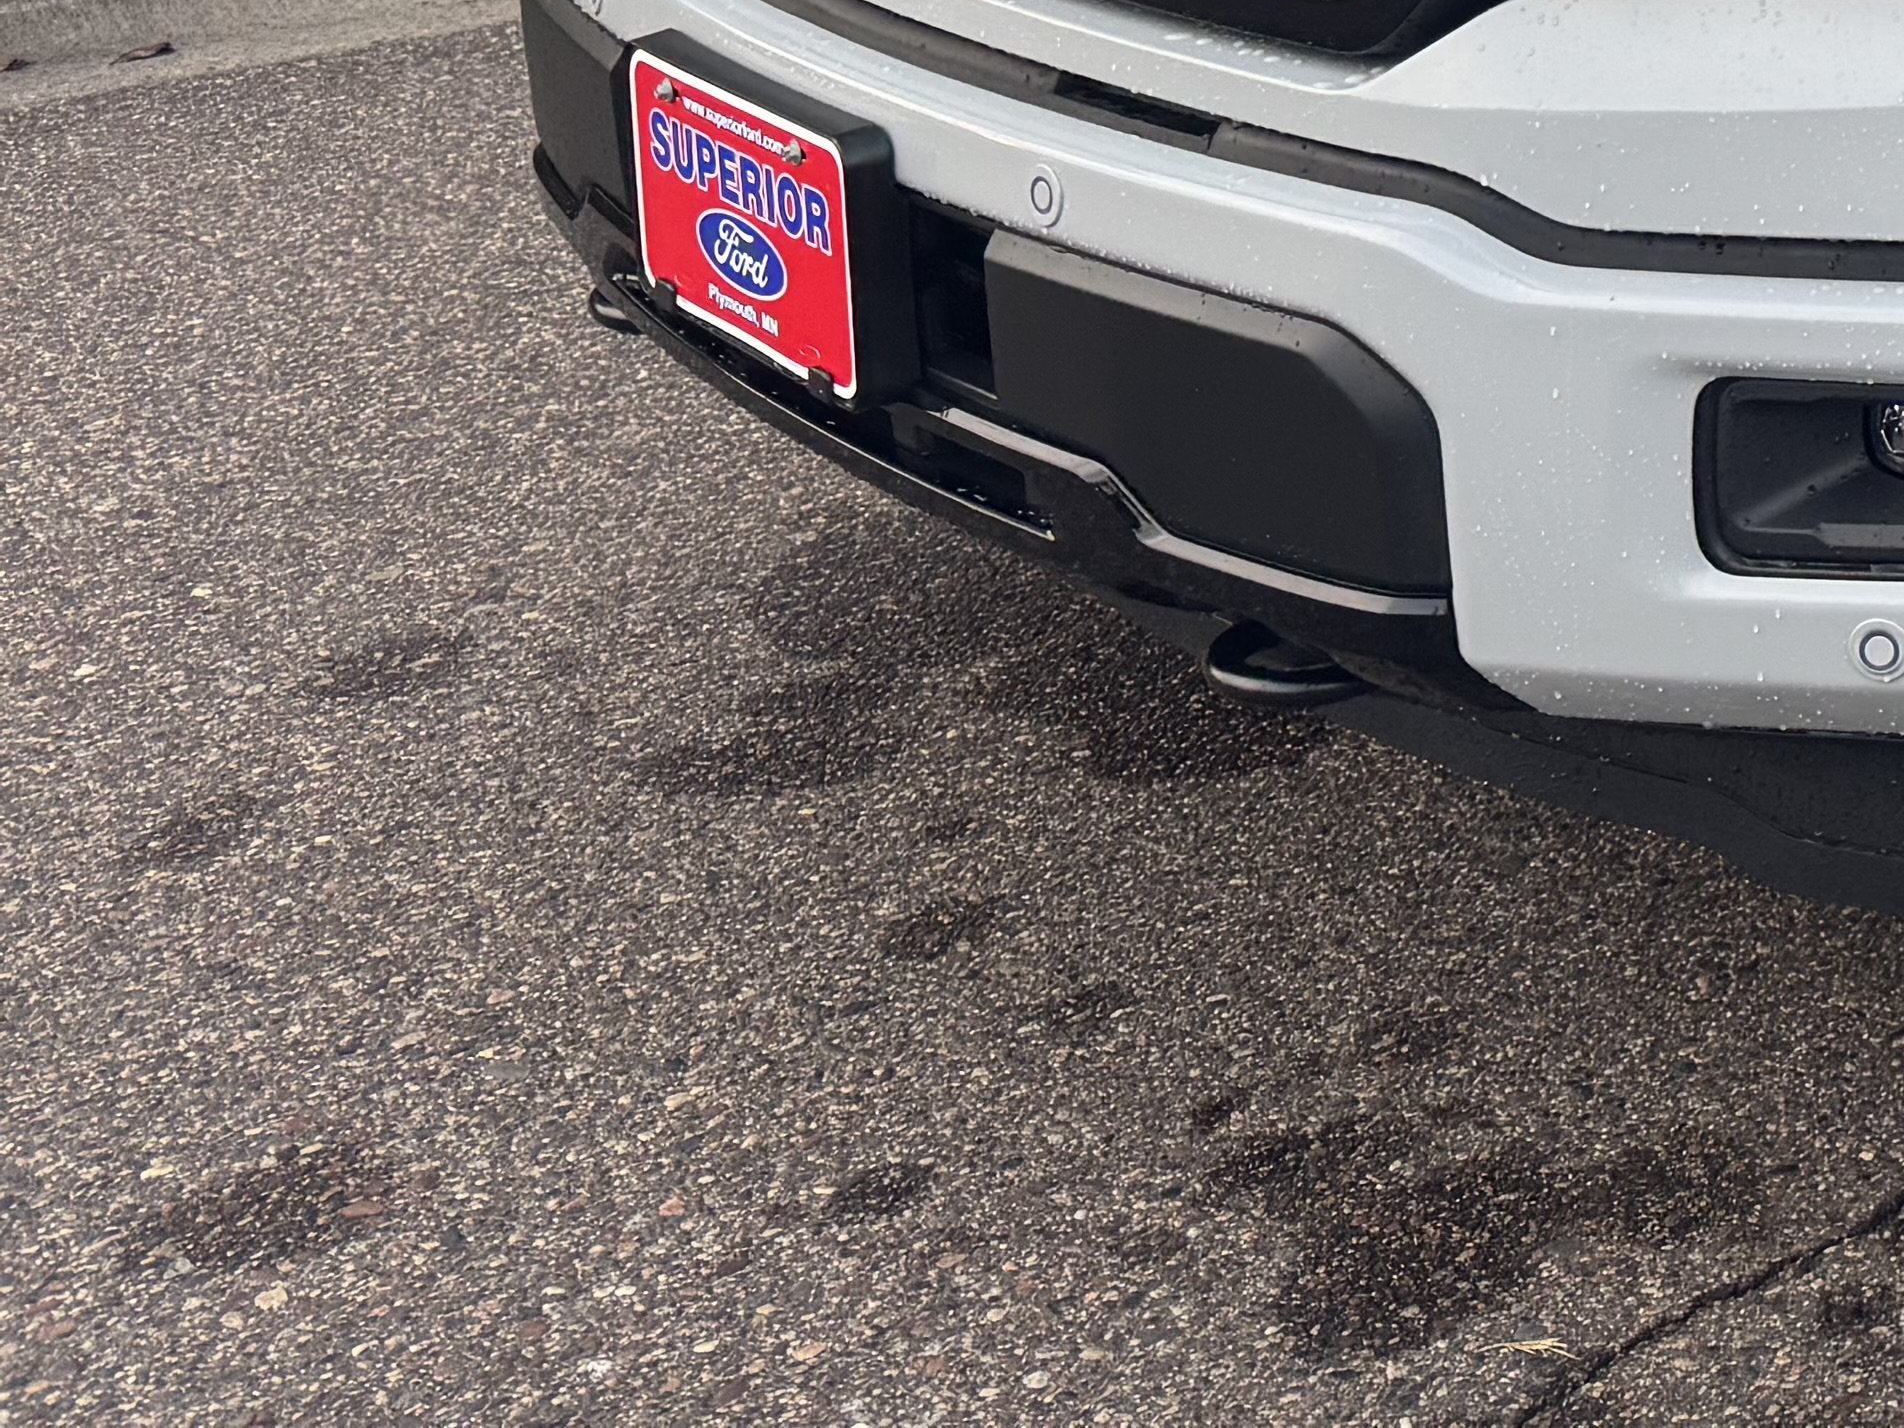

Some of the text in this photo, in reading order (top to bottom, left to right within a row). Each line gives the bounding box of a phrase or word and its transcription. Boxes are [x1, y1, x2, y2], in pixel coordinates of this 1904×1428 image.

[649, 106, 833, 257] SUPERIOR
[714, 219, 770, 290] Ford
[761, 309, 780, 338] MN
